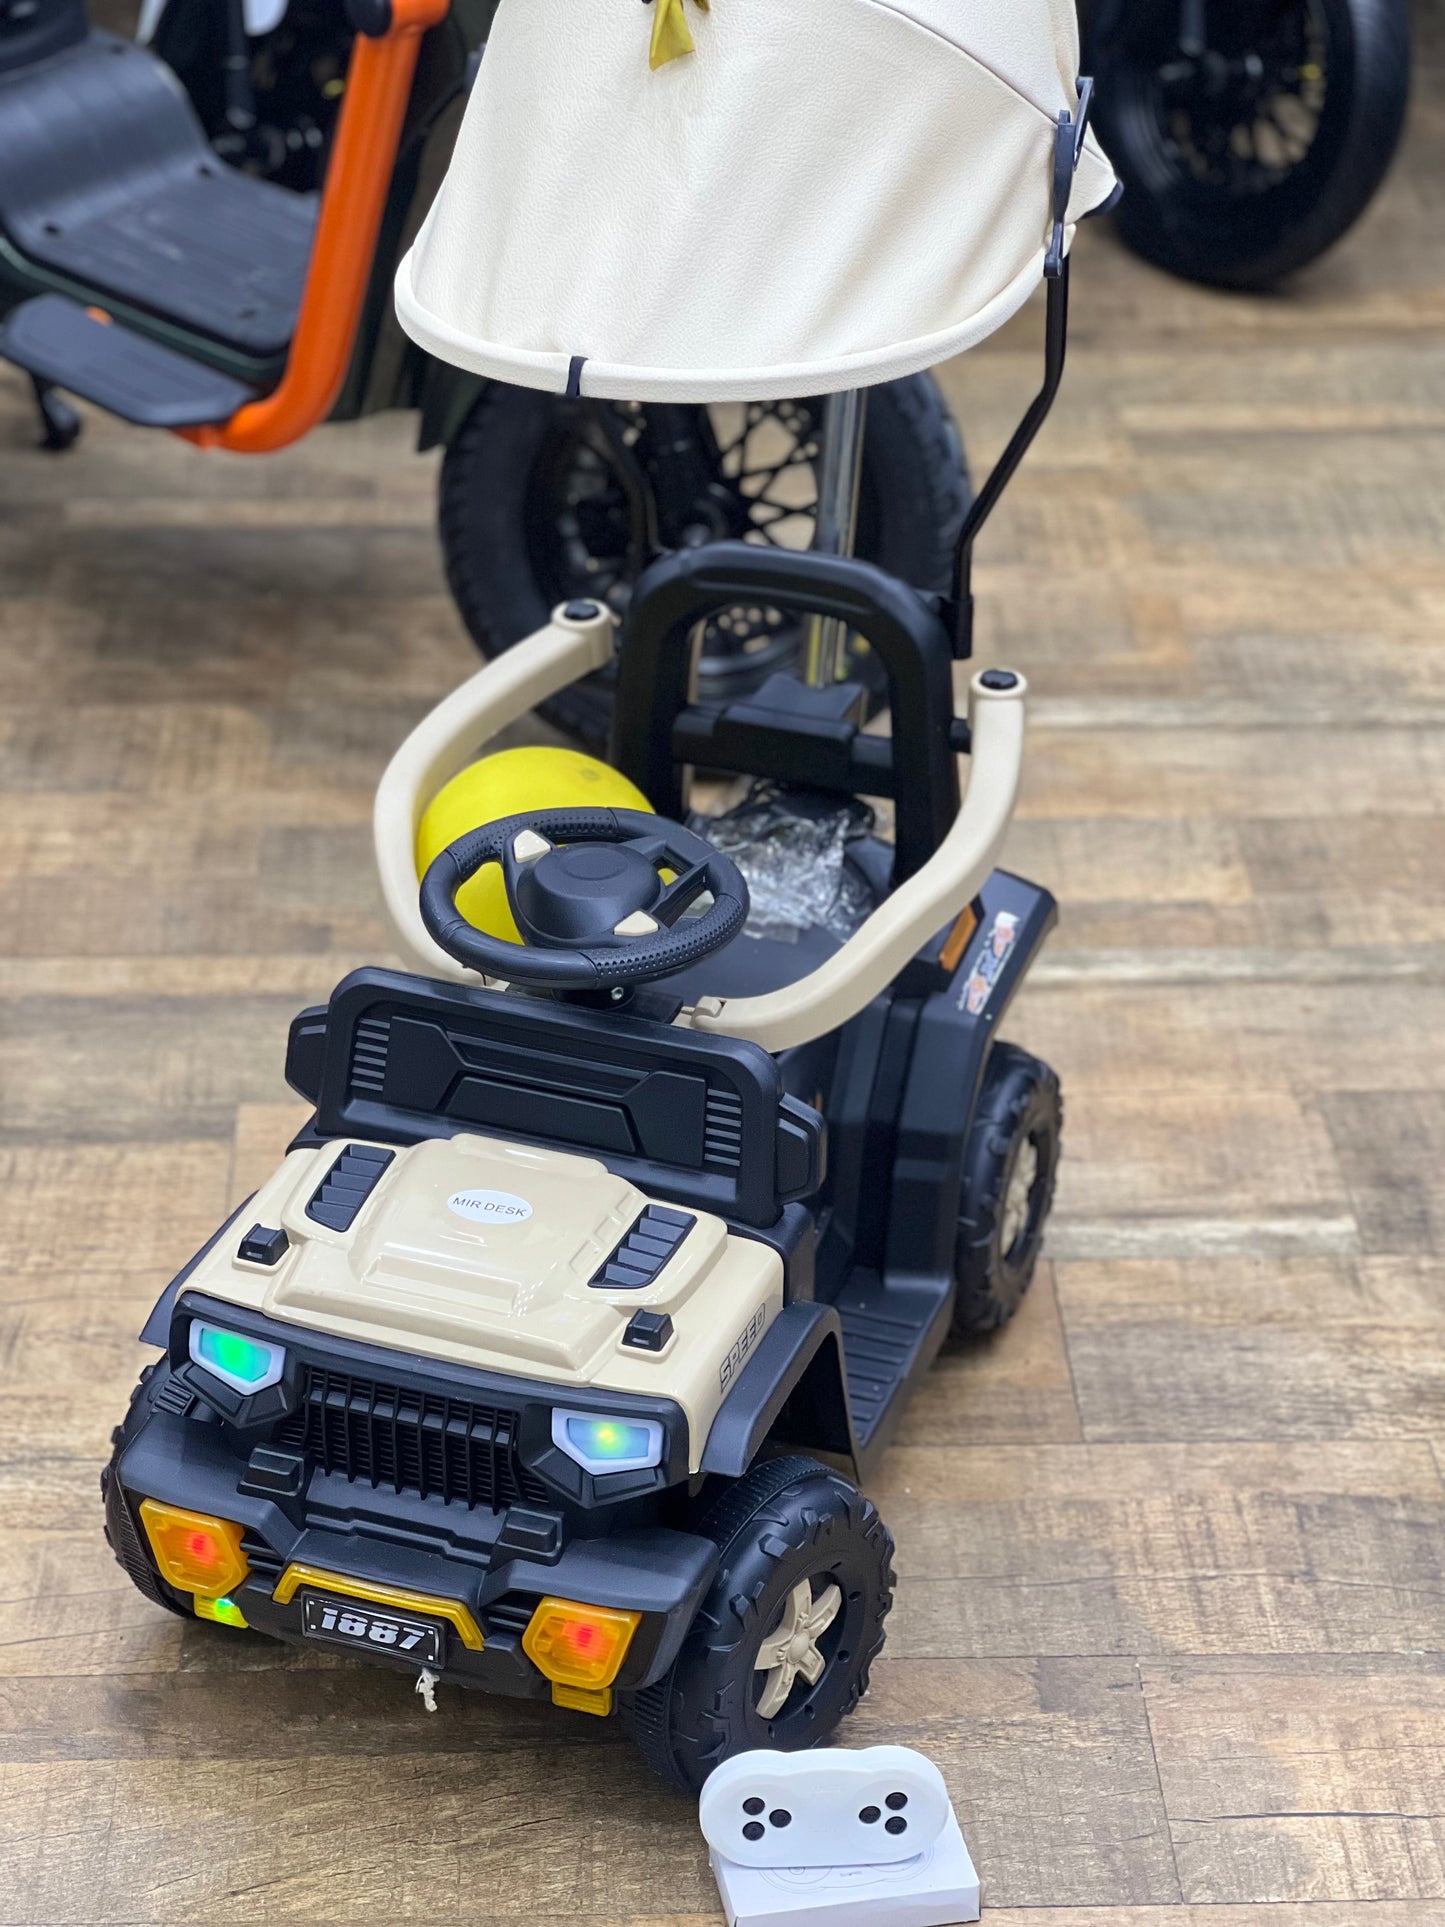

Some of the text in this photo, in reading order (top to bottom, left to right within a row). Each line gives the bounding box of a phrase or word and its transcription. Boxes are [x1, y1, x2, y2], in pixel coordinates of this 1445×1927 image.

[452, 1197, 527, 1217] MIR DESK
[719, 1302, 766, 1394] SPEED
[321, 1607, 426, 1650] 1887
